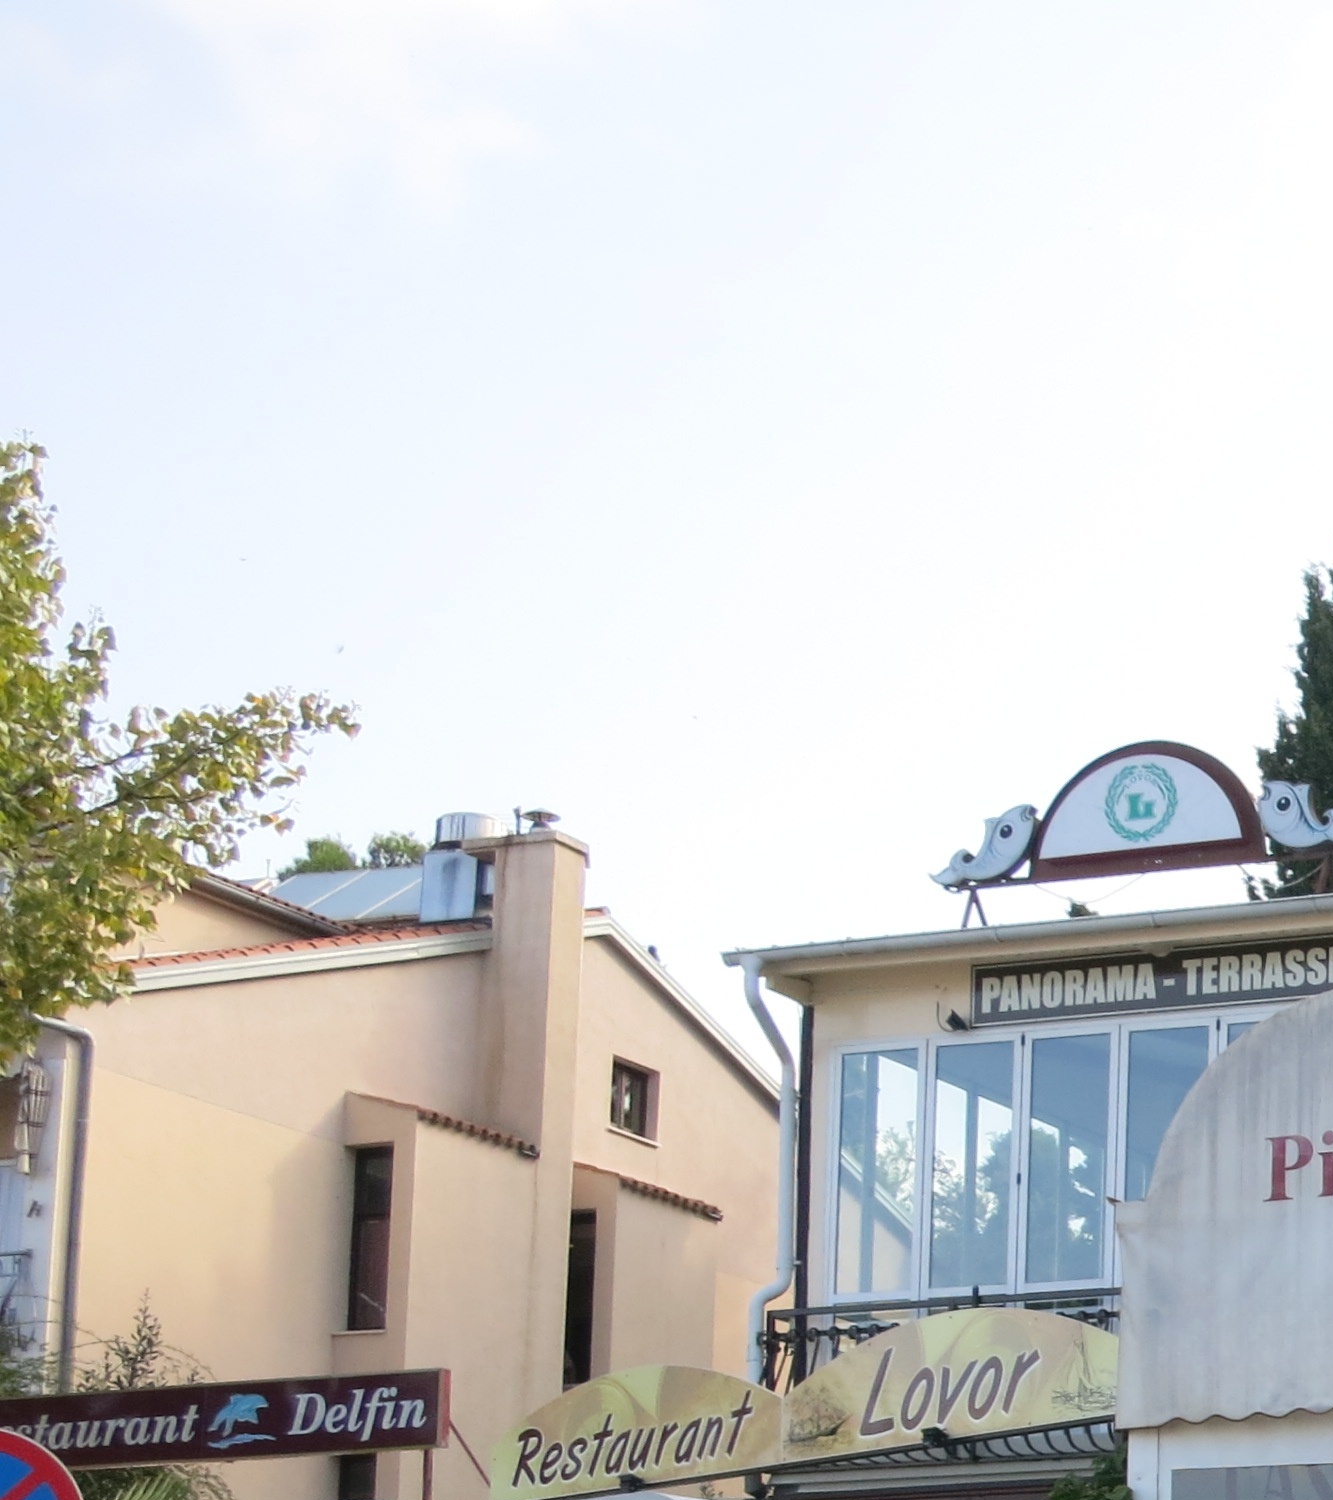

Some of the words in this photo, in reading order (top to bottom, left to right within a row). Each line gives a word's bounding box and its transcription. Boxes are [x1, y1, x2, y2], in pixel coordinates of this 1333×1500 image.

[981, 962, 1156, 1014] PANORAMA
[288, 1387, 427, 1443] Delfin
[512, 1390, 753, 1488] Restaurant
[859, 1347, 1041, 1437] Lovor
